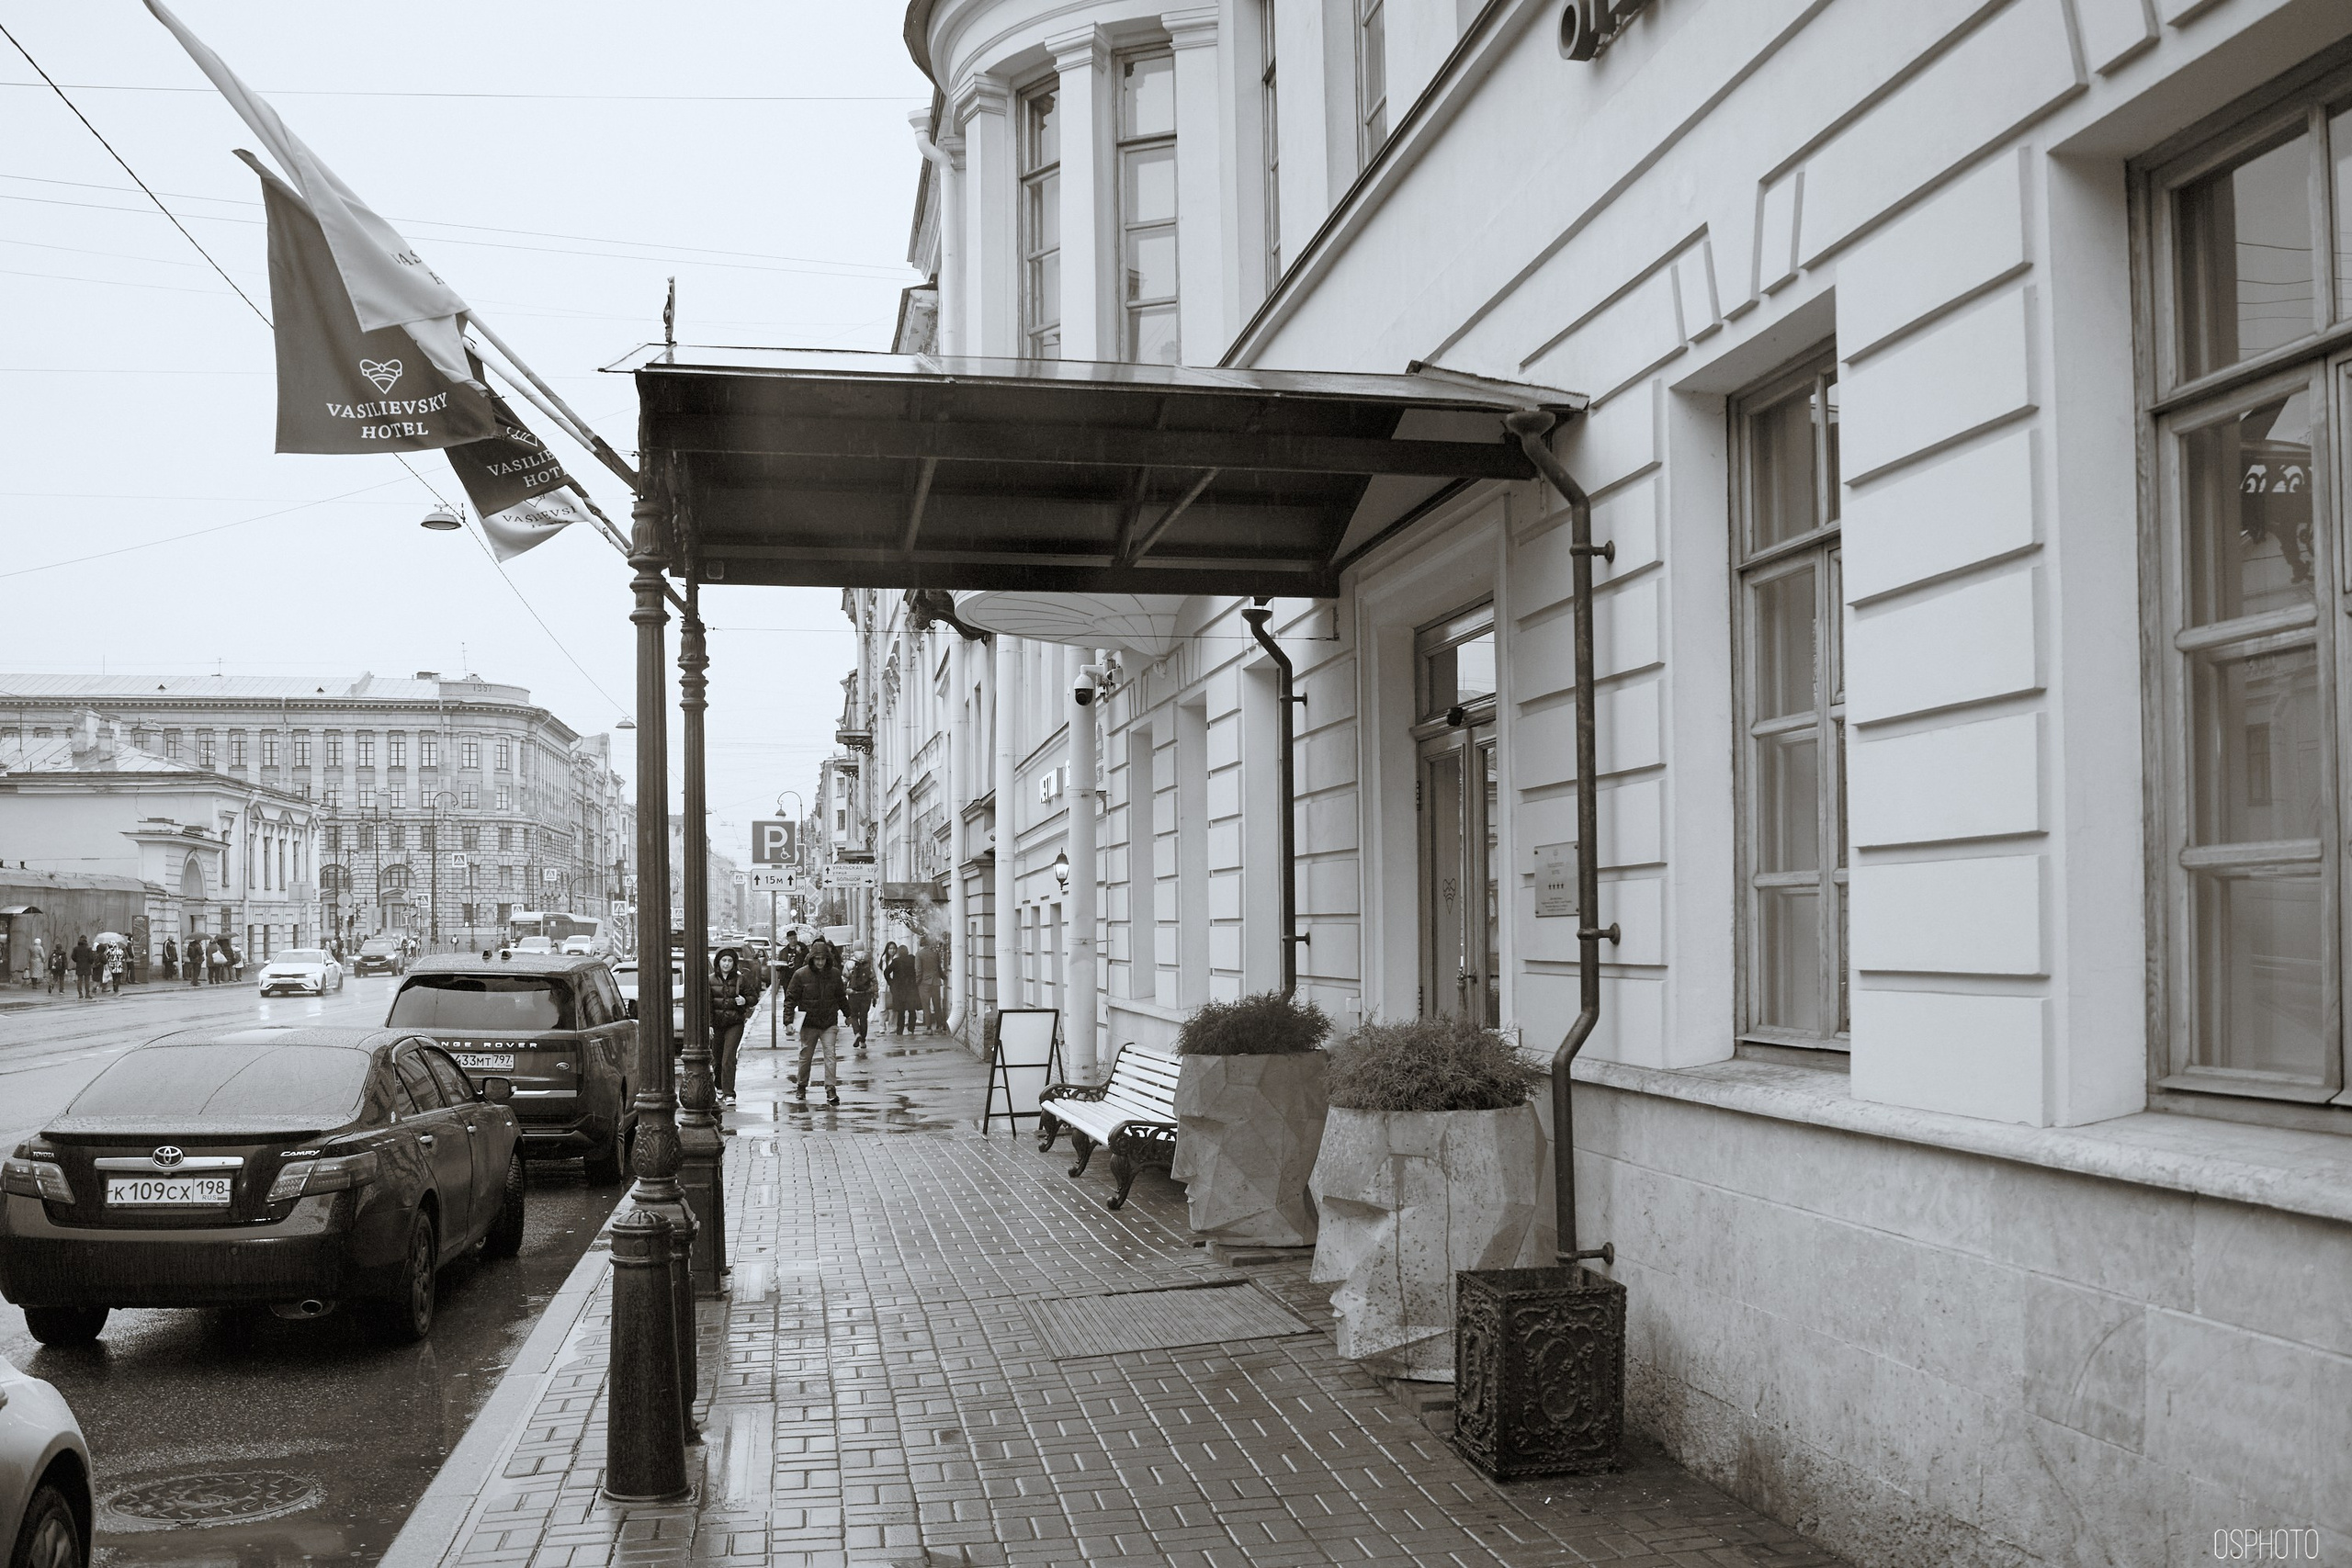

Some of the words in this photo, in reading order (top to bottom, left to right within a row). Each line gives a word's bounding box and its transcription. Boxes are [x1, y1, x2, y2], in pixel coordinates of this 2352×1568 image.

[326, 392, 447, 419] VASILIEVSKY
[361, 422, 429, 439] HOTEL
[487, 449, 556, 477] VASILIE
[523, 466, 568, 488] HOT
[764, 825, 788, 860] P
[493, 1055, 511, 1065] 797
[196, 1180, 225, 1195] 198
